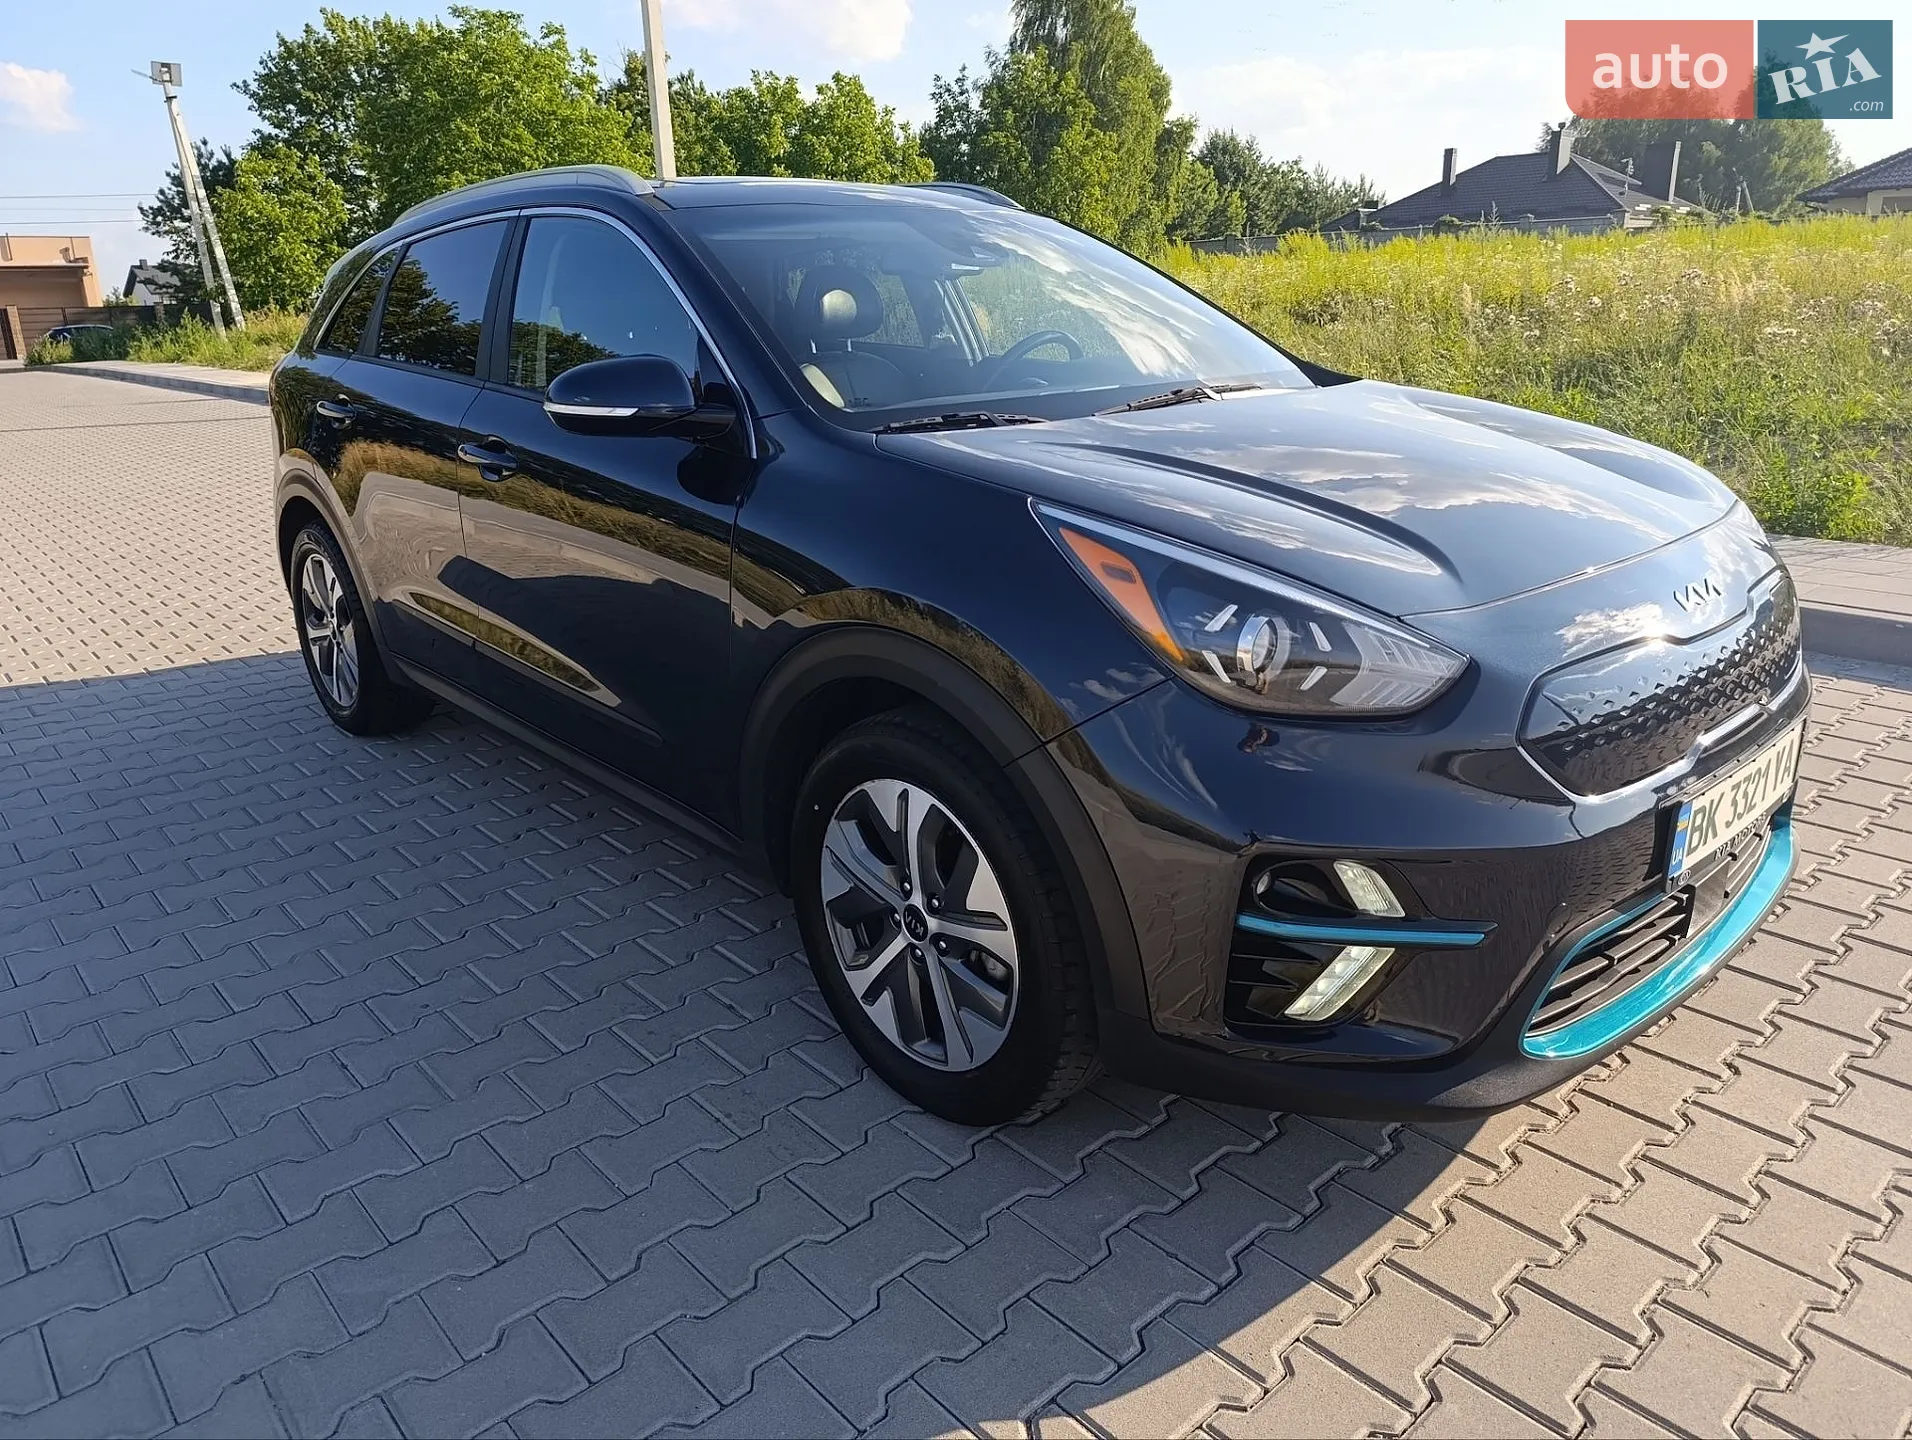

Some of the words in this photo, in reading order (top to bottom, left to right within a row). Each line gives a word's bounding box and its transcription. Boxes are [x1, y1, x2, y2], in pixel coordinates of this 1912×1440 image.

[1686, 791, 1725, 857] BK
[1725, 758, 1771, 829] 3321
[1773, 739, 1794, 792] YA
[1671, 847, 1684, 865] UA
